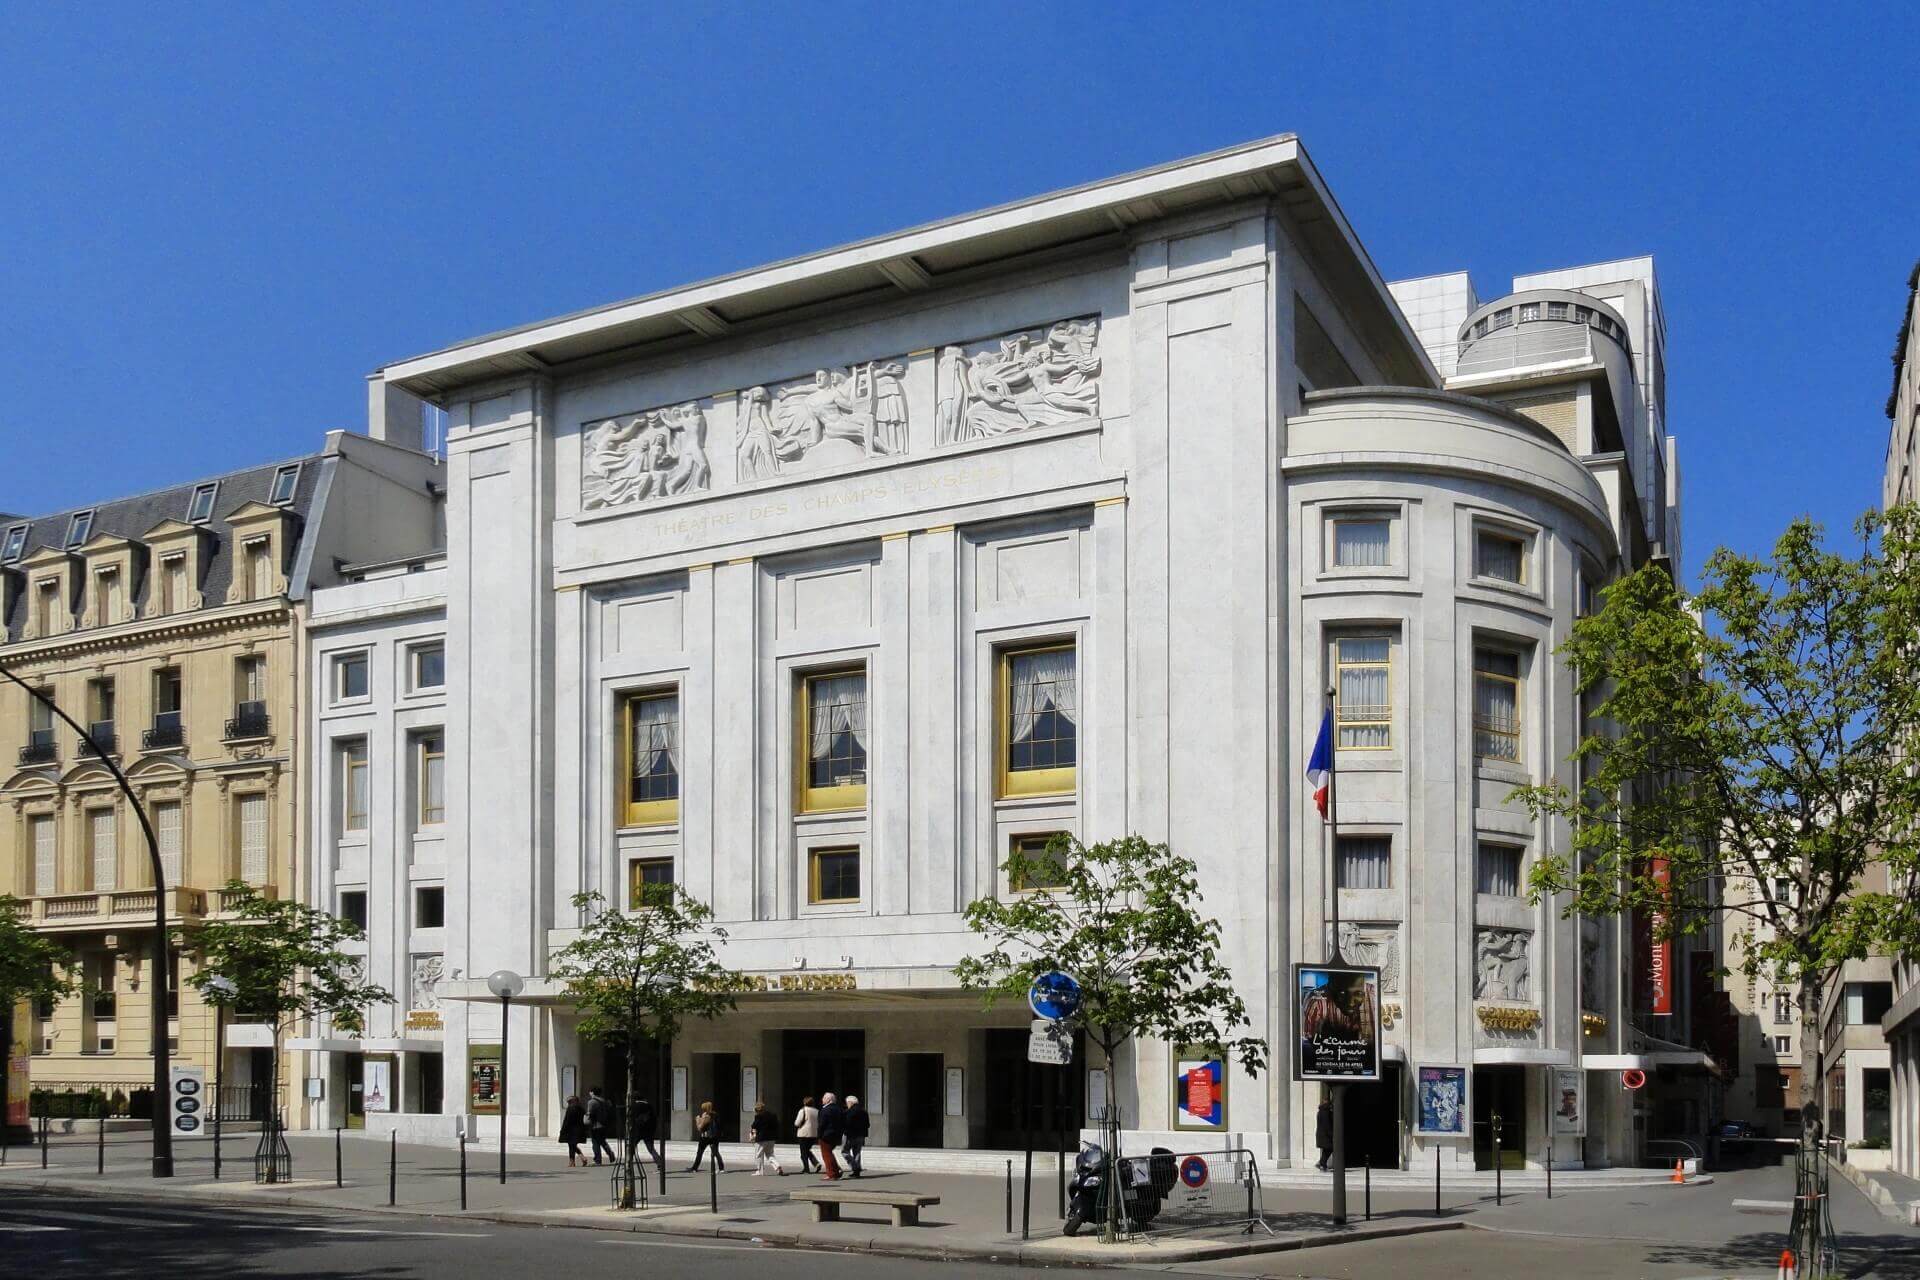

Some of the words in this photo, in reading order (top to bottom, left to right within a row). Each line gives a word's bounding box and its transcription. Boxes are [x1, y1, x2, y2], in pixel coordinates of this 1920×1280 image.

[750, 503, 789, 521] DES
[803, 486, 888, 512] CHAMPS
[1315, 1045, 1334, 1055] des
[1338, 1045, 1366, 1061] jours
